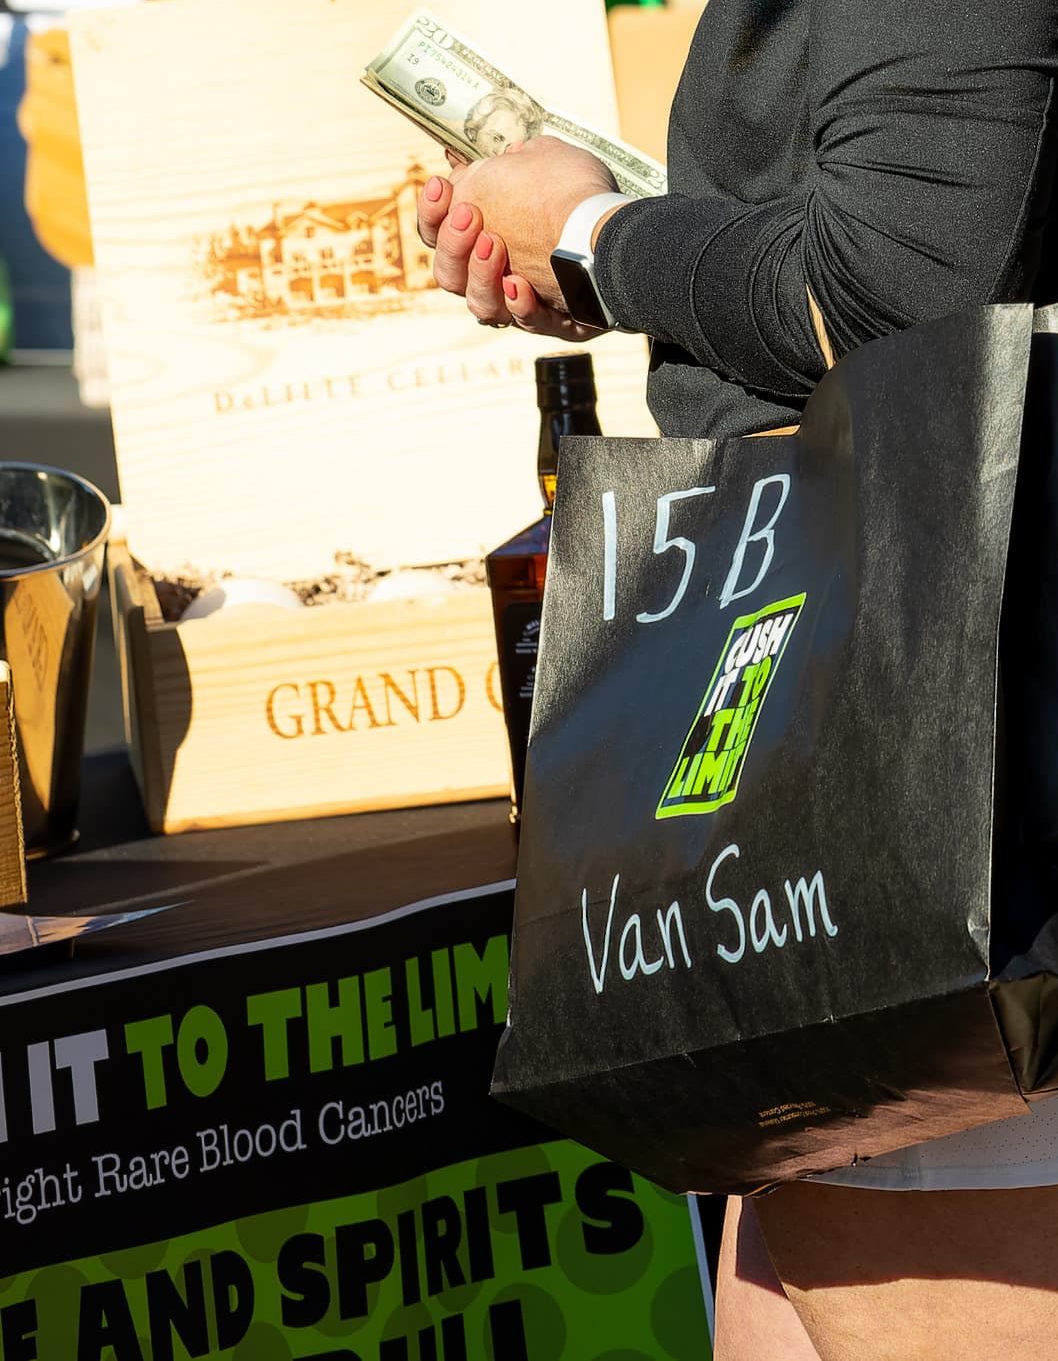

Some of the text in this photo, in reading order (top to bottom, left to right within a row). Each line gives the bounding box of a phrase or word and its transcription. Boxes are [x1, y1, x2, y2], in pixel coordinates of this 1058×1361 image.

[387, 357, 524, 392] CELLAR
[266, 666, 466, 740] GRAND
[703, 655, 772, 717] IT TO
[706, 697, 760, 752] THE
[667, 737, 748, 800] LIMIT
[581, 843, 839, 995] Van Sam
[27, 1028, 110, 1135] IT
[124, 1005, 229, 1111] TO
[247, 966, 399, 1082] THE
[405, 934, 510, 1048] LIM
[0, 1080, 446, 1226] ight Rare Blood Cancers
[77, 1249, 255, 1361] AND
[276, 1160, 645, 1329] SPIRITS
